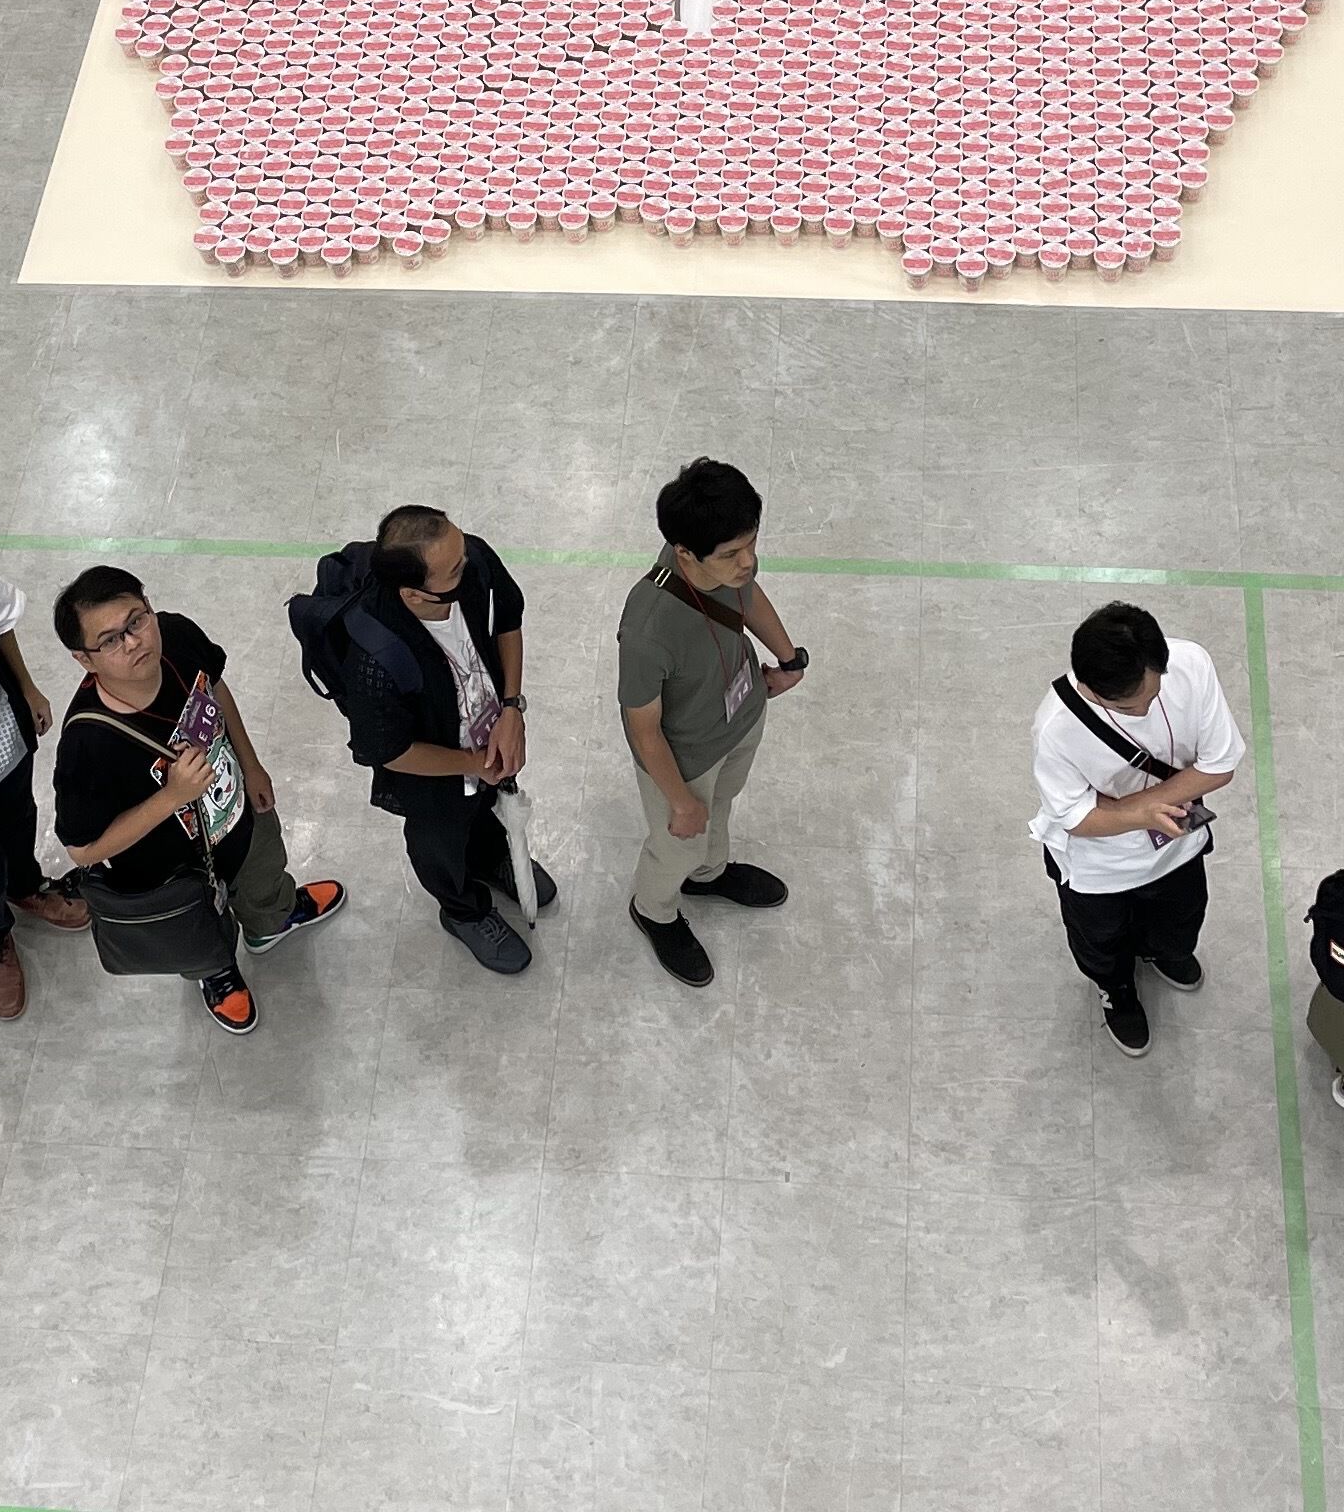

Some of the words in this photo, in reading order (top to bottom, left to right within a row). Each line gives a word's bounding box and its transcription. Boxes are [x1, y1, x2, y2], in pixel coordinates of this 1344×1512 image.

[201, 703, 217, 726] 16
[198, 731, 208, 743] E
[1155, 834, 1165, 846] E
